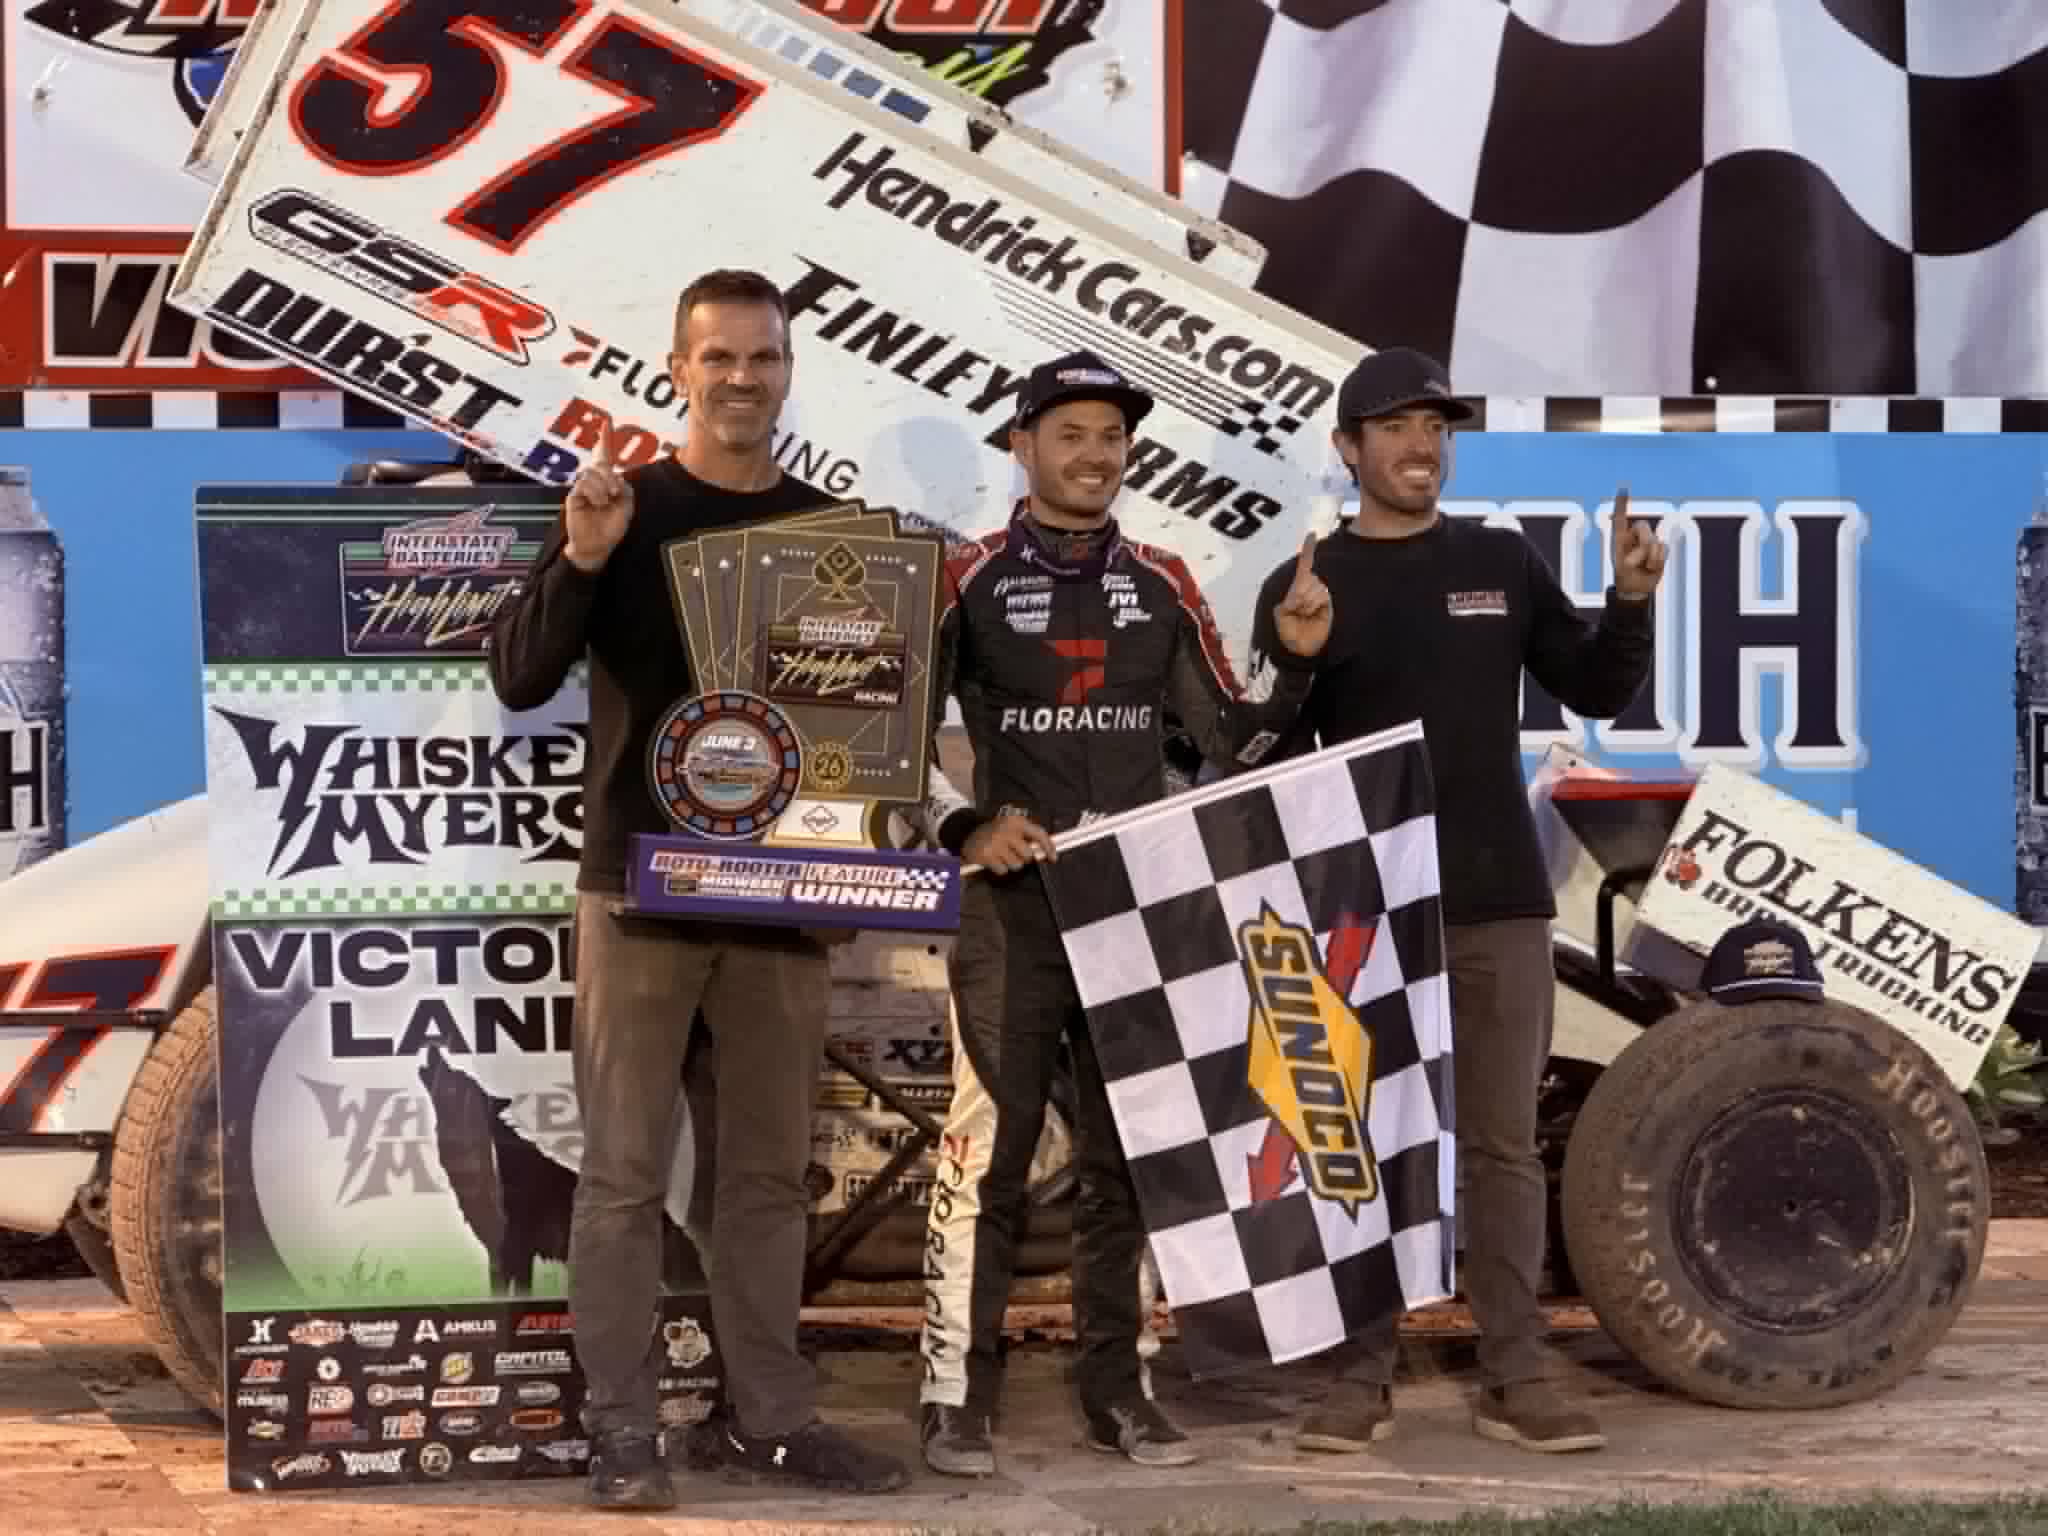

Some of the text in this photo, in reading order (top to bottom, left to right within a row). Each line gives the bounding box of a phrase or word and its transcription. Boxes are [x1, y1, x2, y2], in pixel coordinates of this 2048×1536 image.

[289, 0, 766, 254] 57
[254, 195, 551, 356] GSR
[783, 253, 1026, 416] FINLEY
[210, 704, 587, 790] WHISKE
[702, 735, 741, 749] JUNE
[1000, 705, 1153, 733] FLORACING
[654, 854, 803, 878] ROTO-ROOTER
[791, 883, 940, 912] WINNER
[1681, 808, 2018, 1014] FOLKENS
[231, 927, 574, 988] VICTO
[1815, 939, 1993, 1046] TRUCKING
[1249, 926, 1375, 1192] SUNOCO
[443, 1319, 497, 1334] AMKUS
